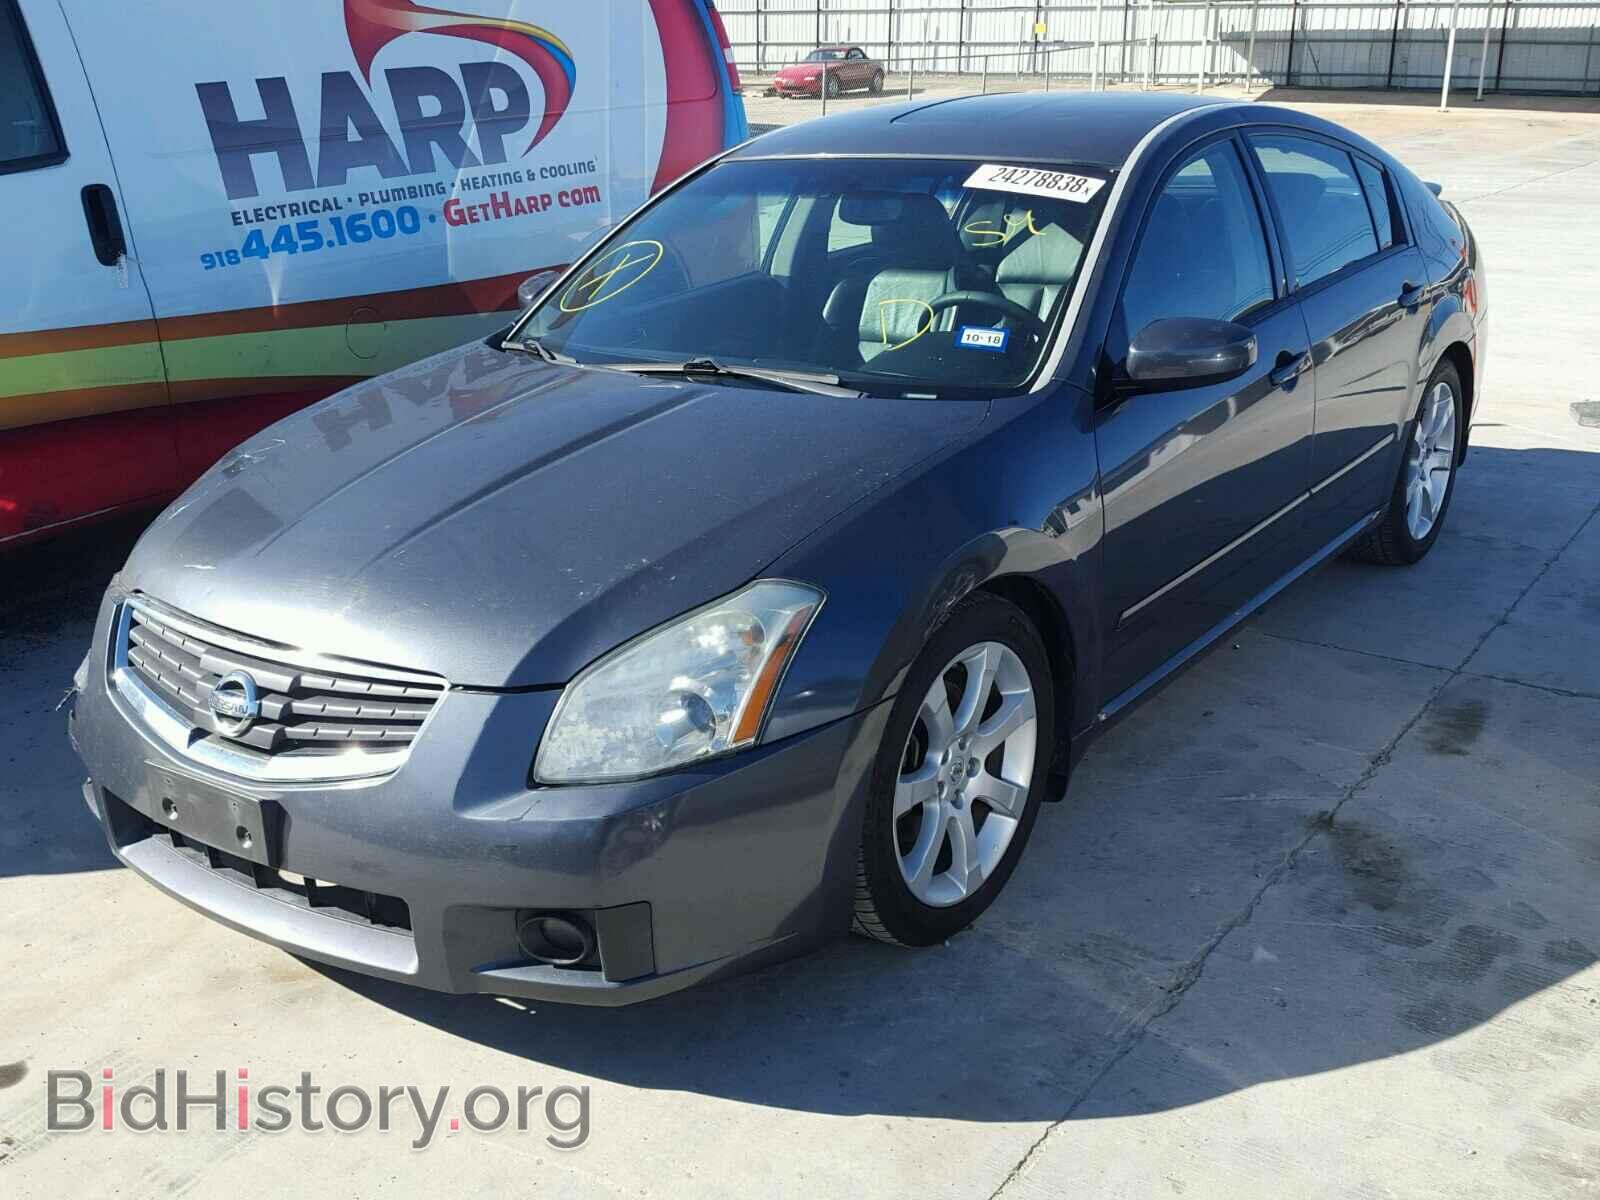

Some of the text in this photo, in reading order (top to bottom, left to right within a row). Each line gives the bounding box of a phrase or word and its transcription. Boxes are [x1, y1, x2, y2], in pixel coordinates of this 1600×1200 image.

[195, 62, 530, 201] HARP
[231, 160, 596, 226] ELECTRICAL PLUMBING HEATING & COOLING
[241, 205, 421, 260] 445.1600
